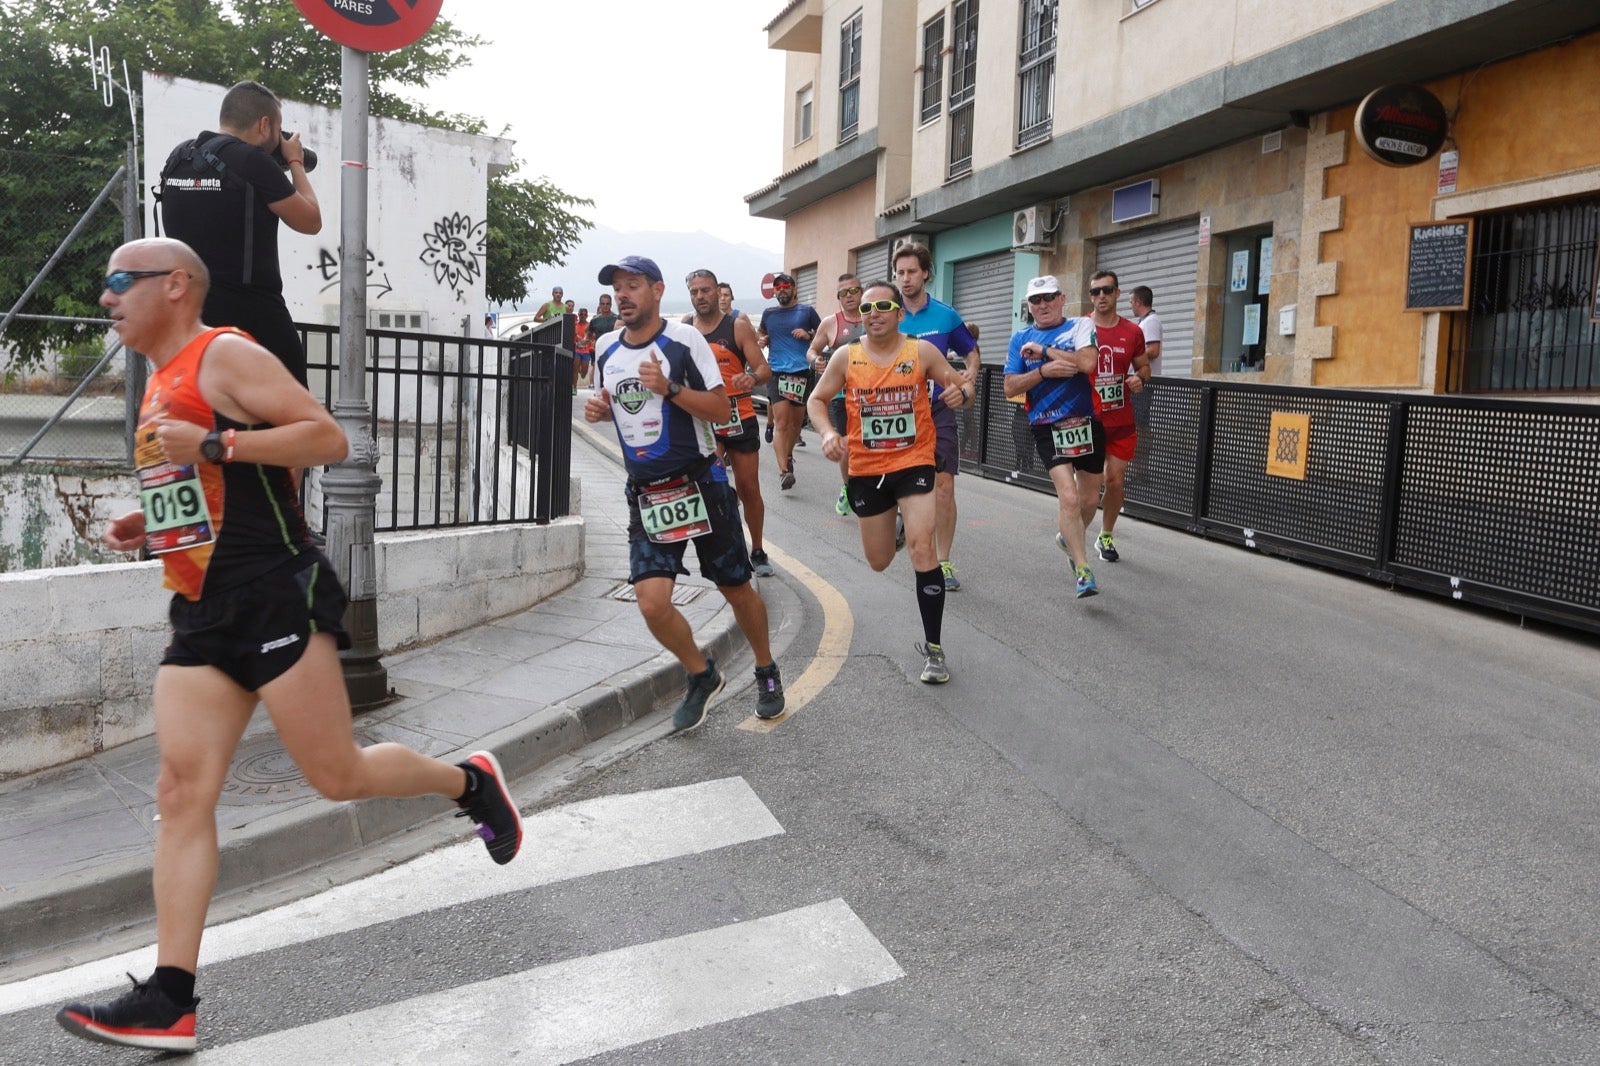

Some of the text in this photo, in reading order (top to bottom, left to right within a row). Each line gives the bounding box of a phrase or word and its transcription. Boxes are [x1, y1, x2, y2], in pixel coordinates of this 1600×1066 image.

[334, 0, 373, 15] PARES
[784, 381, 802, 394] 110
[1099, 386, 1122, 400] 136
[871, 417, 907, 435] 670
[1056, 427, 1089, 445] 1011
[143, 485, 200, 525] 019
[647, 497, 700, 529] 1087
